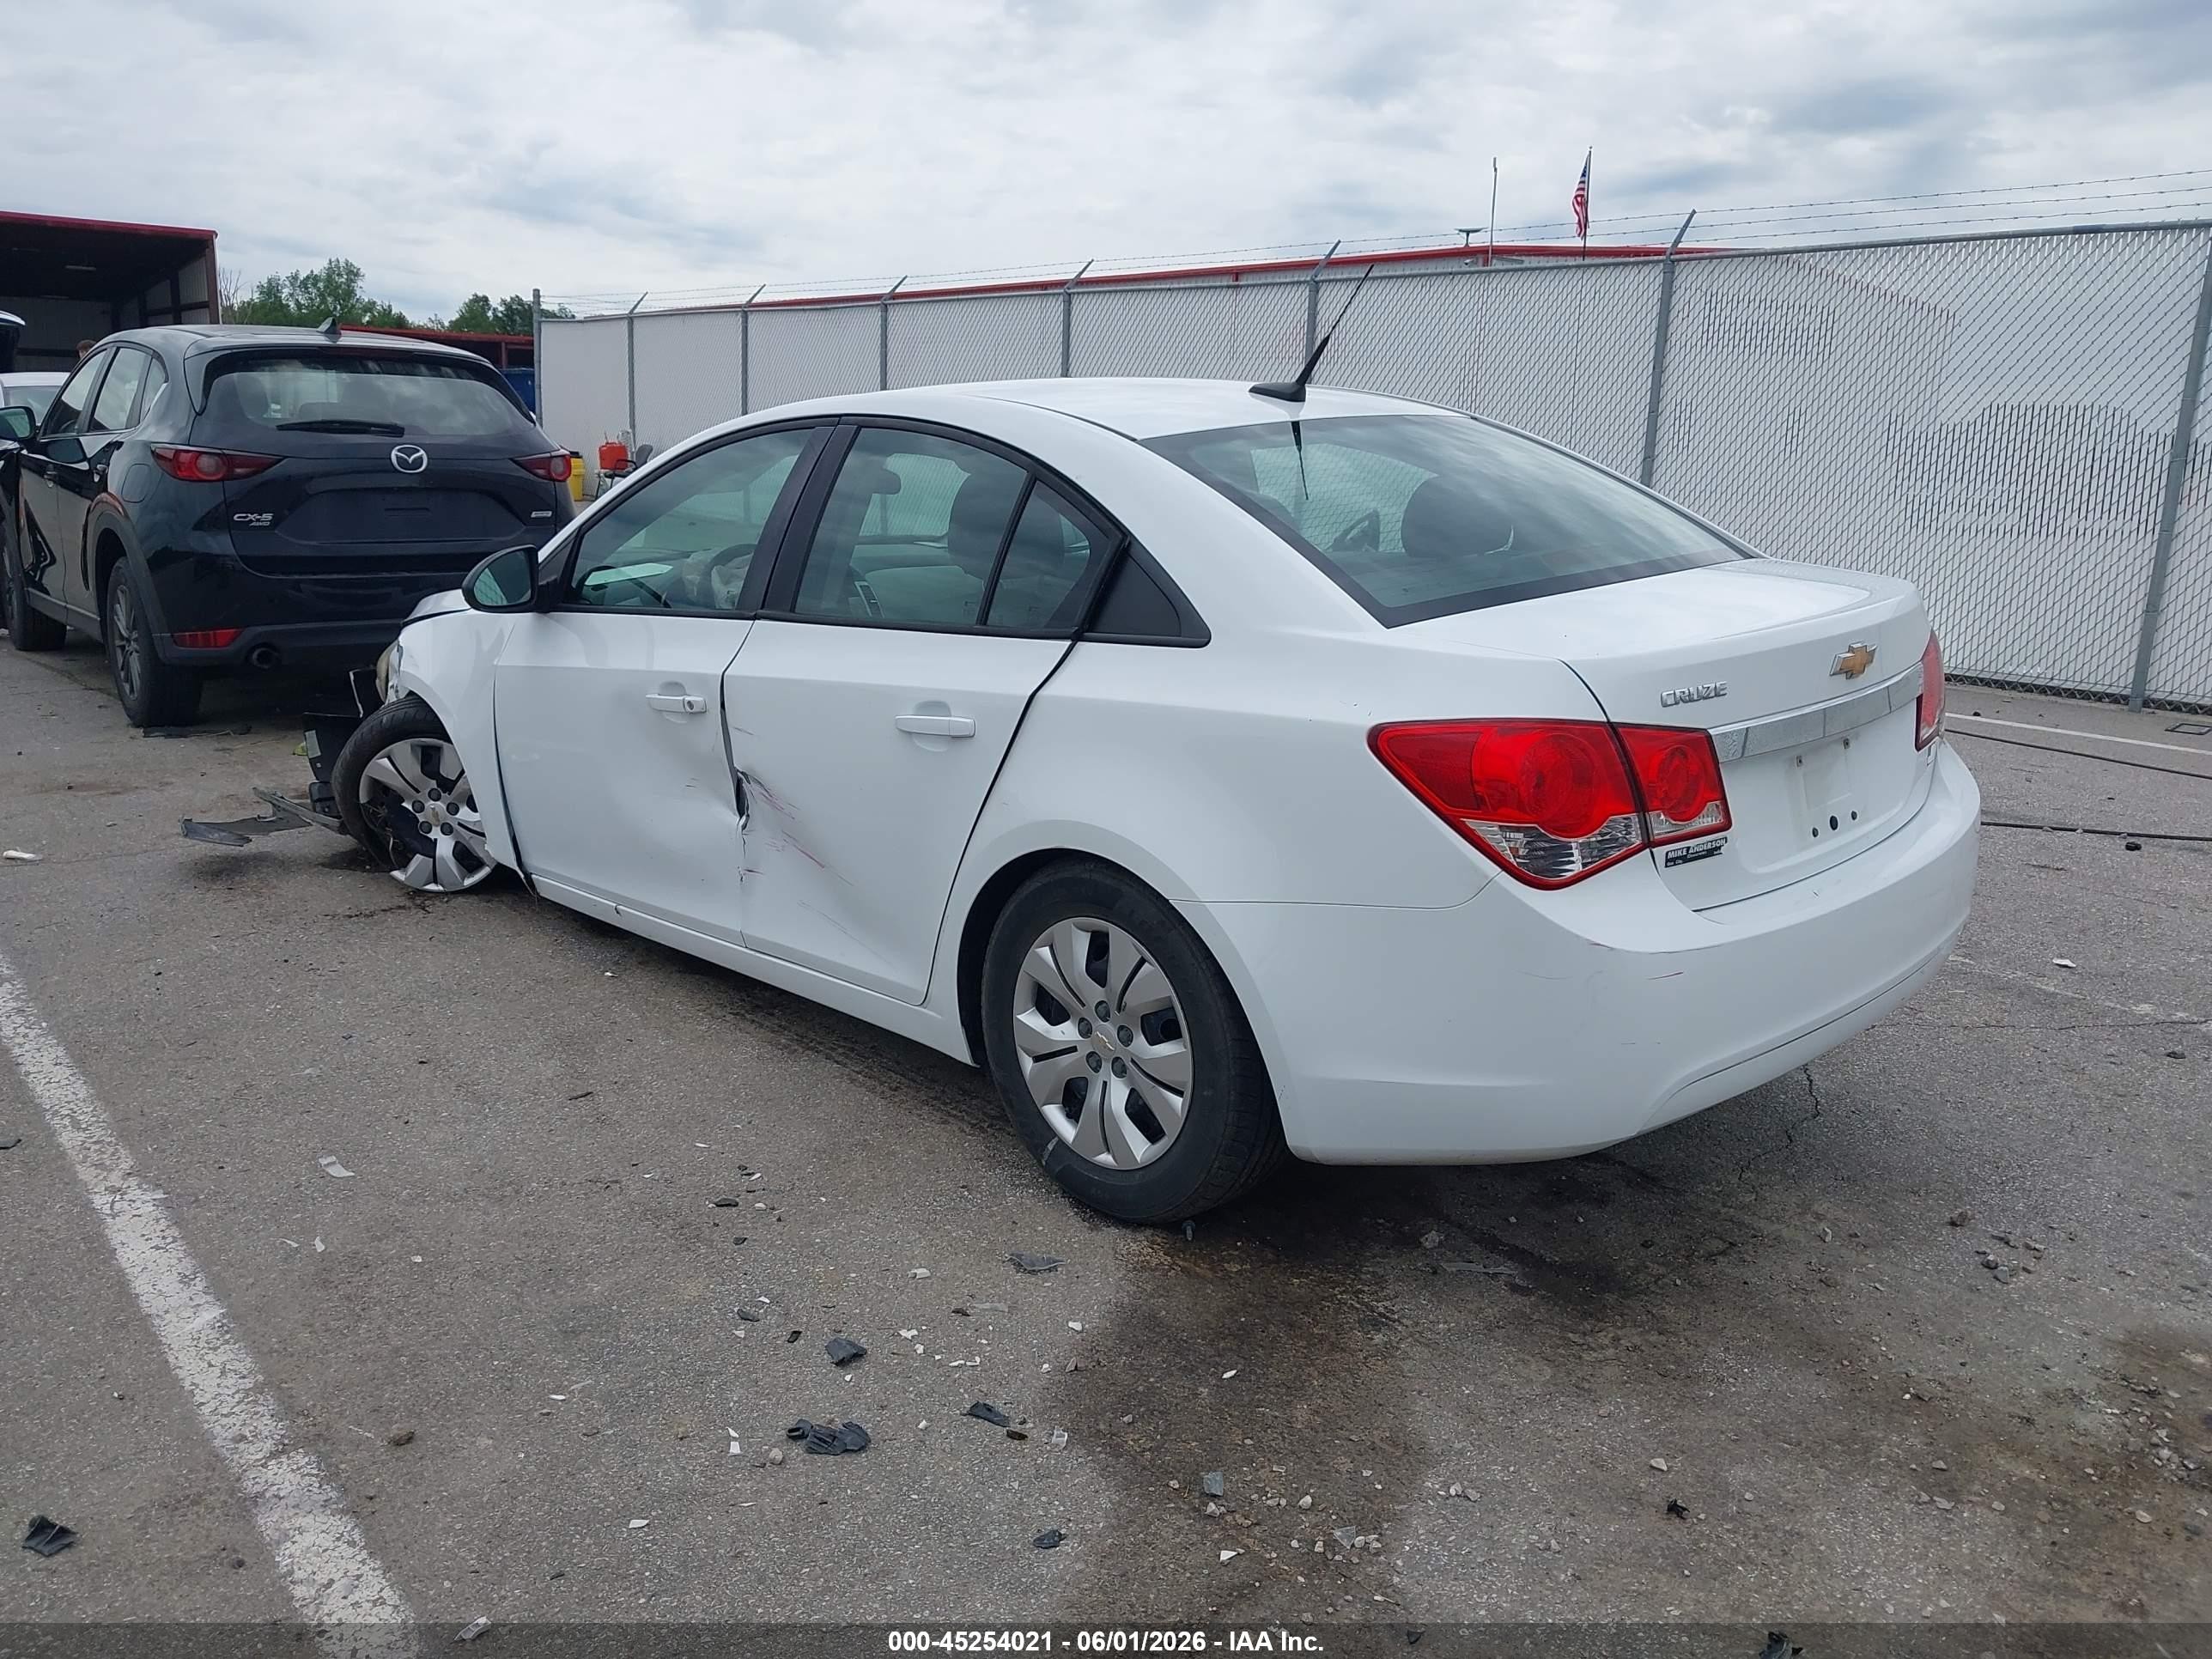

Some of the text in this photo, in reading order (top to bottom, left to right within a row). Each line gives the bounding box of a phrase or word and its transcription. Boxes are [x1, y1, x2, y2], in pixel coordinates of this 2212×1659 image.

[234, 513, 274, 521] CX-5
[1661, 681, 1727, 708] CRUZE
[1668, 848, 1687, 860] MIKE
[1688, 837, 1727, 854] ANDERSON
